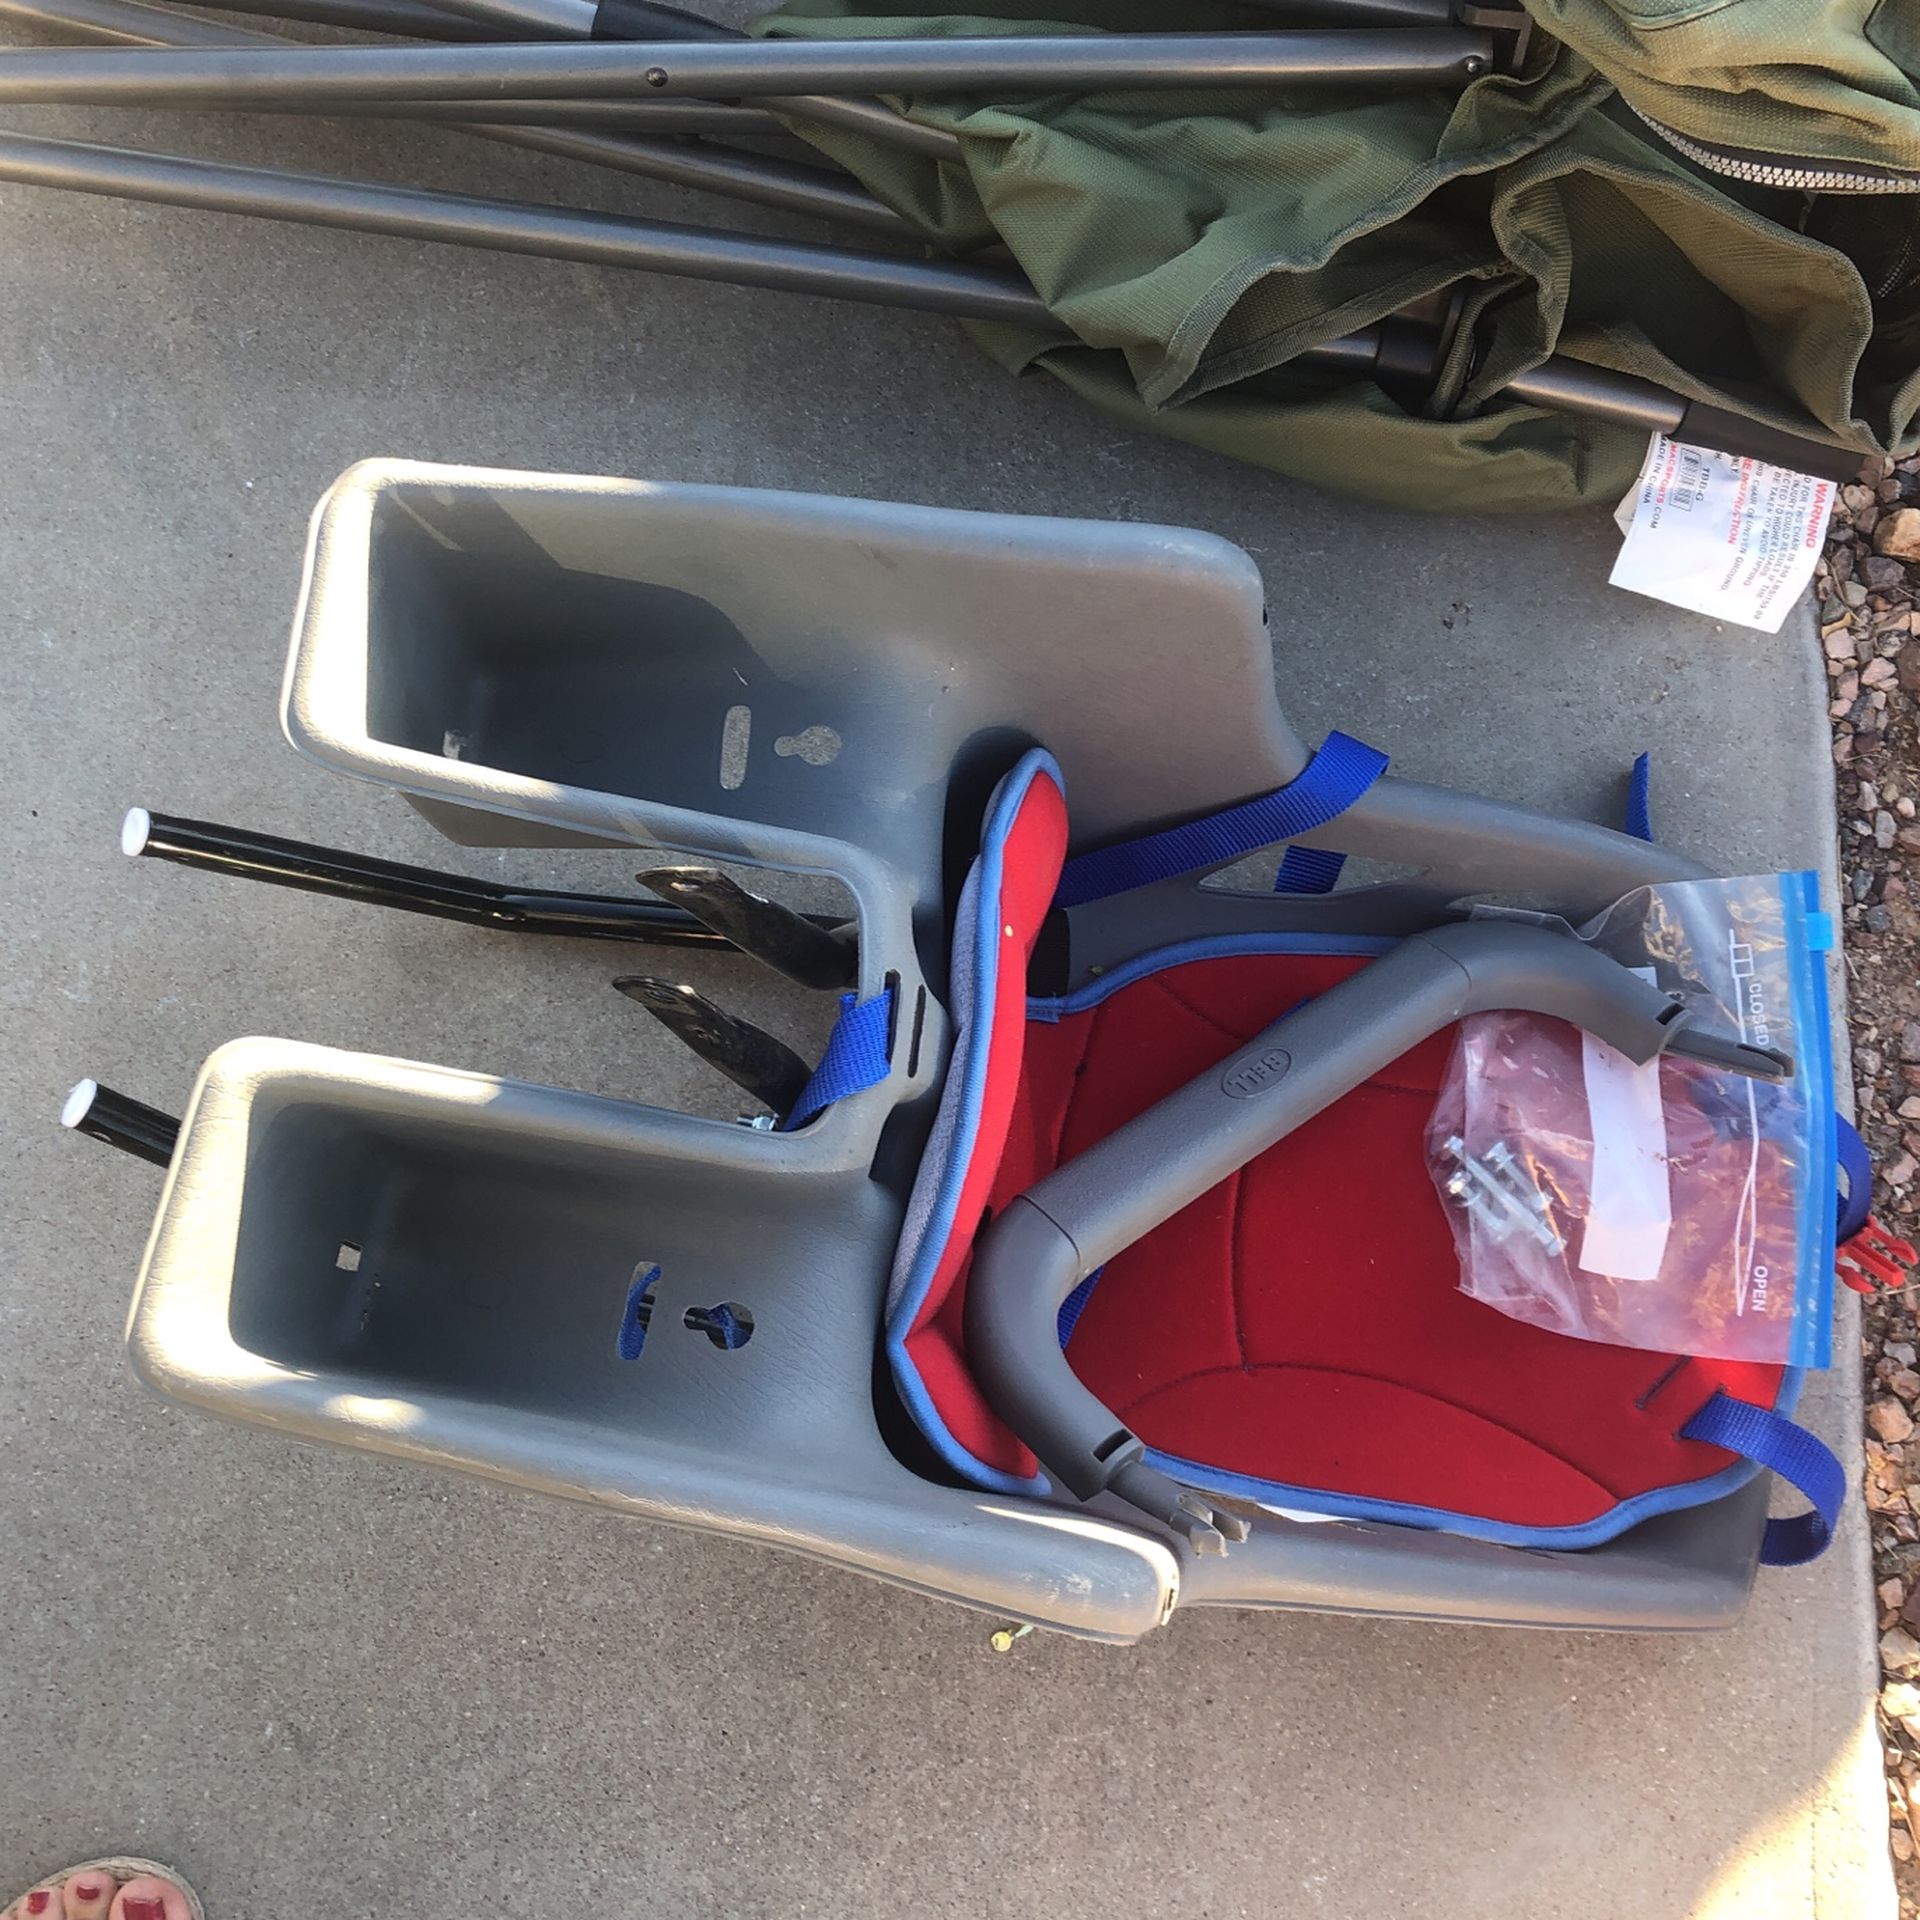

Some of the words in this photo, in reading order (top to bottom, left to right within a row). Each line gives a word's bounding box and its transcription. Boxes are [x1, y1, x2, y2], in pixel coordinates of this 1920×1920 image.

[1653, 463, 1662, 473] IN
[1643, 476, 1657, 504] CHINA
[1750, 480, 1759, 504] CHAIR
[1767, 486, 1778, 514] TAKEN
[1788, 480, 1799, 510] INJURY
[1800, 485, 1810, 503] FOR
[1728, 473, 1750, 544] INSTRUCTION
[1764, 516, 1772, 527] TO
[1776, 503, 1785, 514] TO
[1806, 483, 1828, 548] WARNING
[1739, 520, 1754, 554] UNEVEN
[1770, 516, 1781, 547] HIGHER
[1782, 511, 1793, 540] COULD
[1790, 525, 1801, 551] CHAIR
[1759, 528, 1769, 553] AVOID
[1743, 556, 1765, 586] TIPPING
[1771, 541, 1788, 573] RESULT
[1749, 983, 1769, 1046] CLOSED
[1226, 1055, 1282, 1093] BELL
[1752, 1265, 1768, 1312] OPEN
